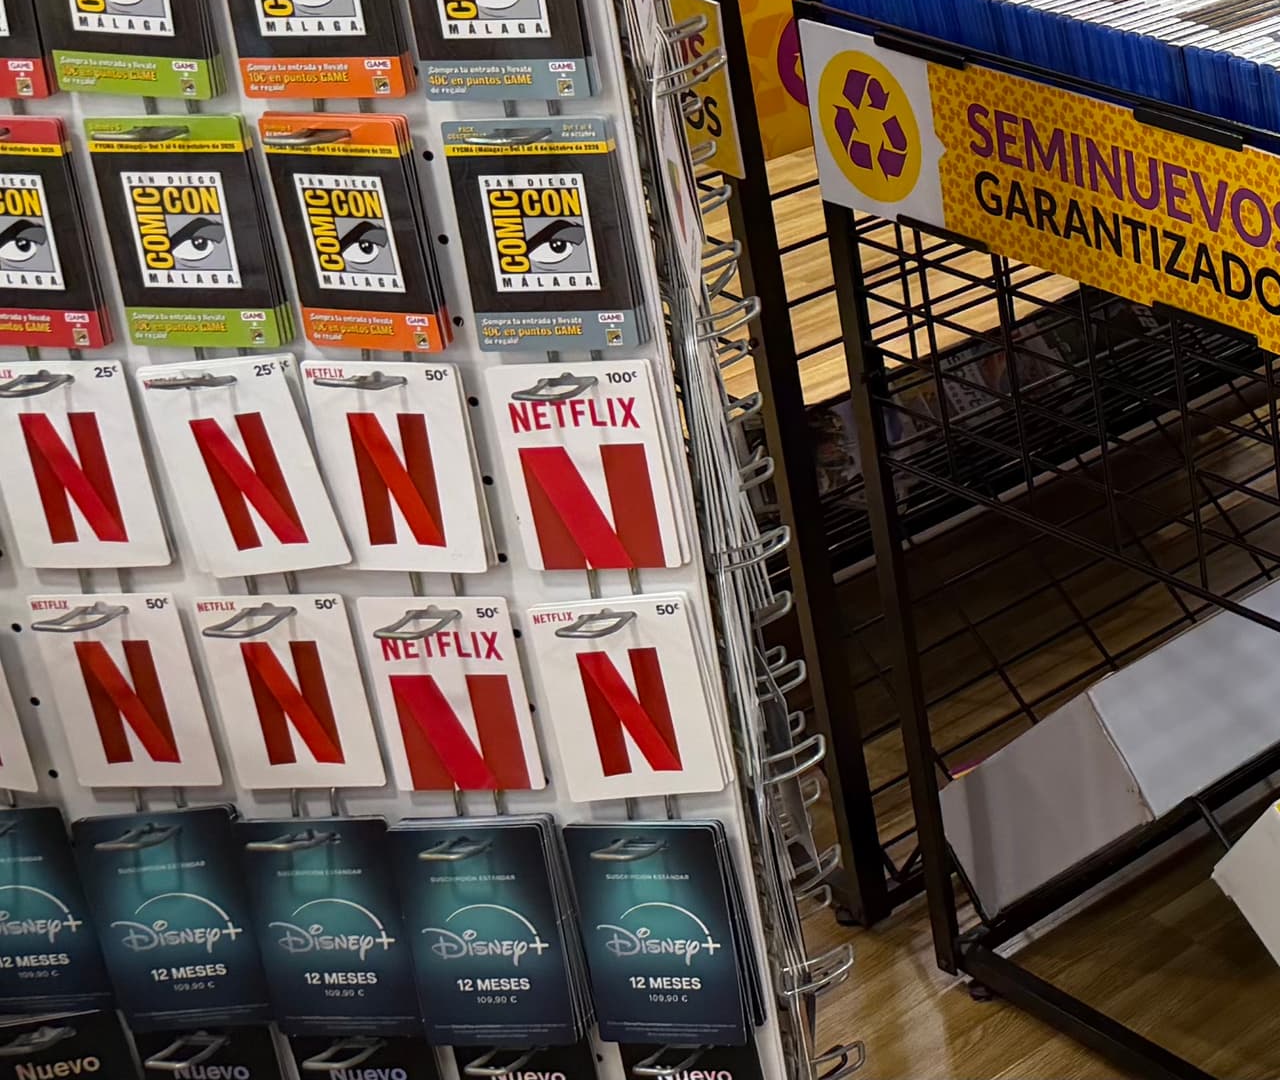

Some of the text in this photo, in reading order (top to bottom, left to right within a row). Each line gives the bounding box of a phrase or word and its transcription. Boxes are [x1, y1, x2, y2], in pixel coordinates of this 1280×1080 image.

[504, 75, 532, 85] GAME
[94, 366, 116, 378] 25€
[306, 368, 344, 379] NETFLIX
[425, 370, 447, 381] 50€
[606, 371, 637, 383] 100€
[508, 397, 640, 433] NETFLIX
[597, 927, 720, 966] Disney+
[457, 978, 530, 991] 12 MESES
[15, 1056, 100, 1080] Nuevo
